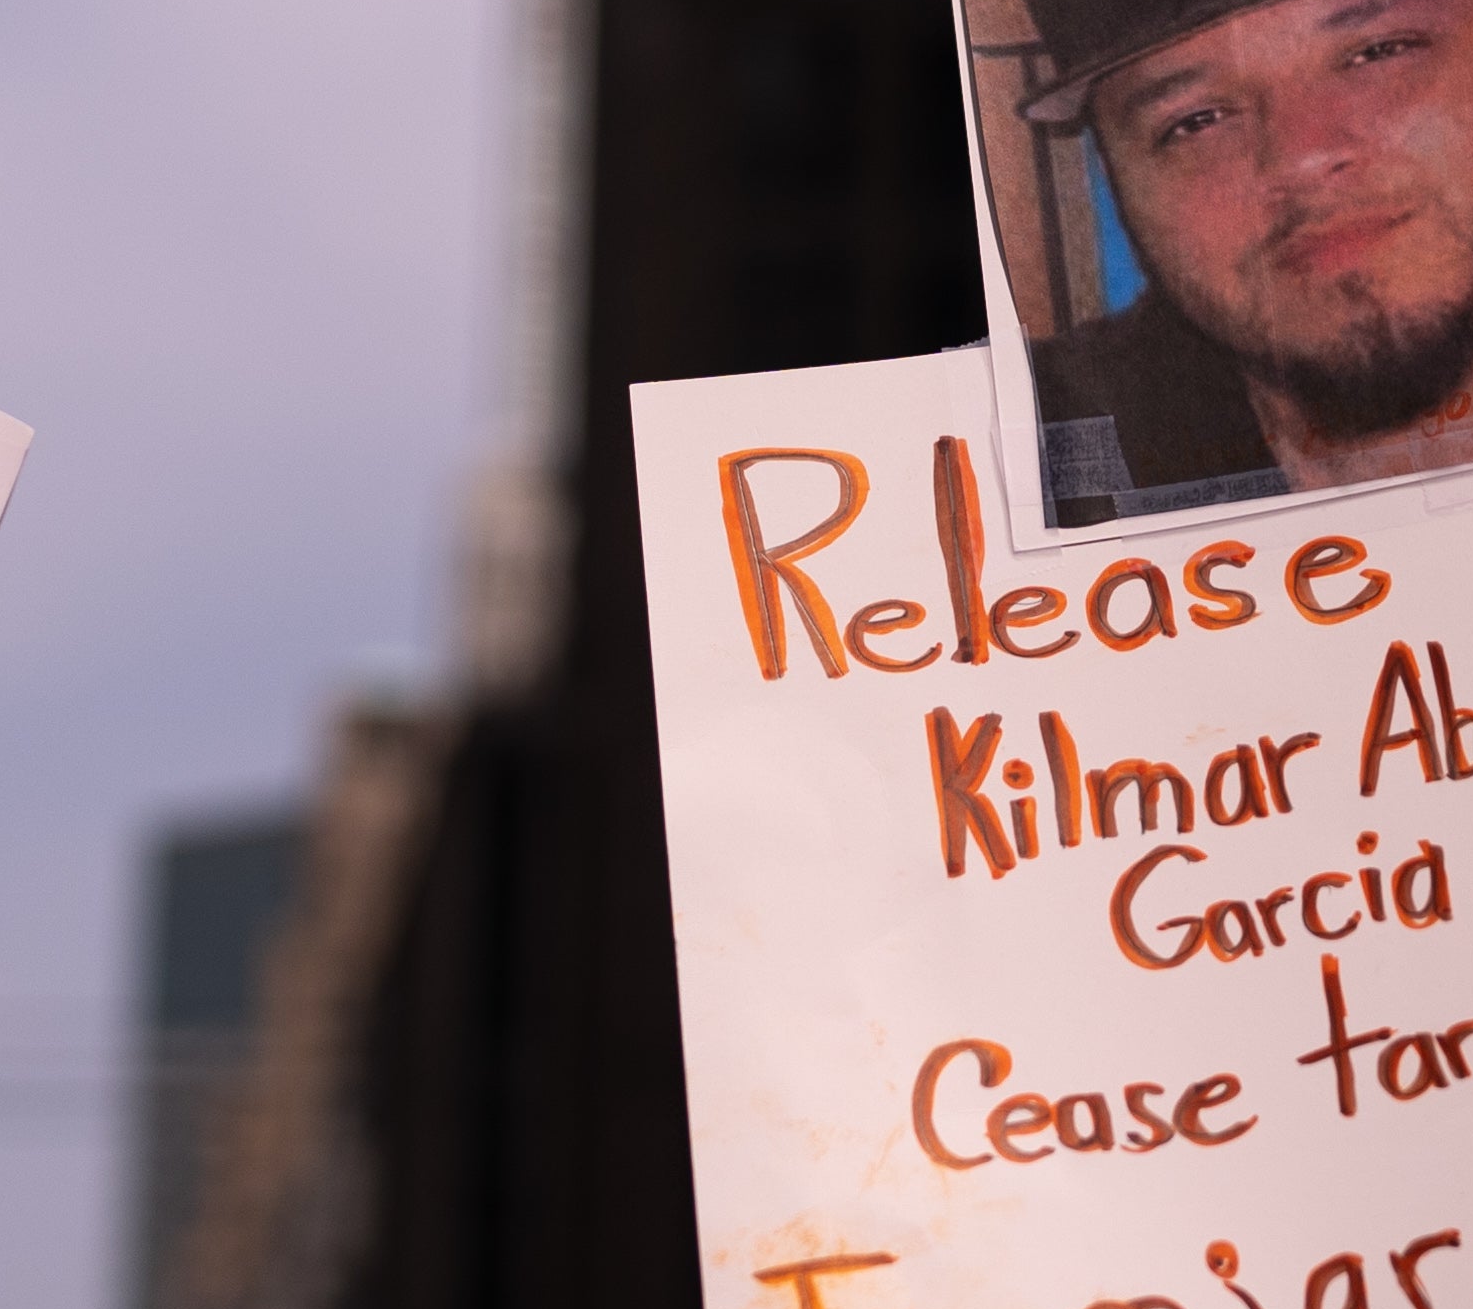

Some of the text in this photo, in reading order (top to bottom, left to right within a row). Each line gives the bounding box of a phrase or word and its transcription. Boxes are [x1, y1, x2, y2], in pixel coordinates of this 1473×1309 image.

[717, 435, 1392, 681] Release
[924, 706, 1323, 880] Kilmar
[1109, 831, 1453, 971] Garcia
[912, 1038, 1259, 1170] Cease
